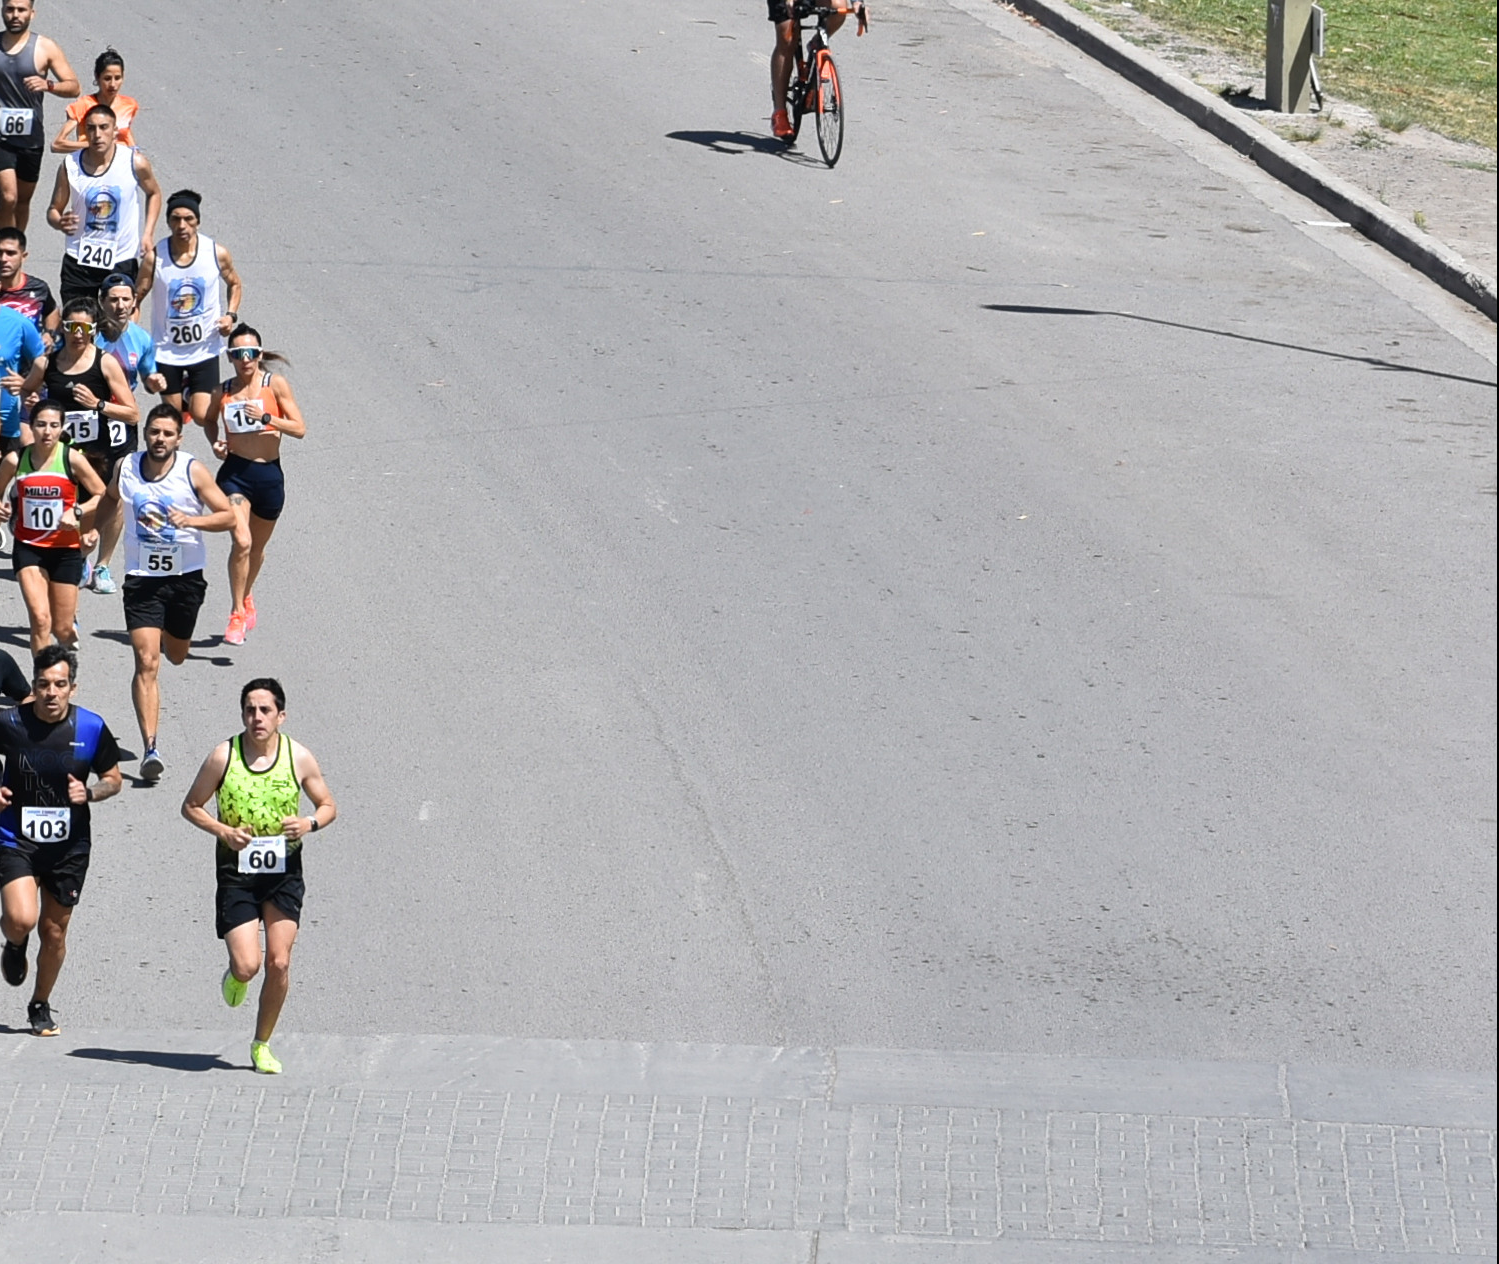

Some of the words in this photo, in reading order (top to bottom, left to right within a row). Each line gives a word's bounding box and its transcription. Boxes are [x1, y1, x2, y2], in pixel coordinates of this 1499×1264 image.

[5, 115, 25, 134] 66
[81, 244, 113, 268] 240
[170, 324, 202, 344] 260
[67, 421, 91, 438] 15
[24, 486, 61, 497] MILLA
[30, 506, 54, 528] 10
[148, 555, 173, 572] 55
[25, 821, 67, 838] 103
[249, 850, 277, 869] 60
